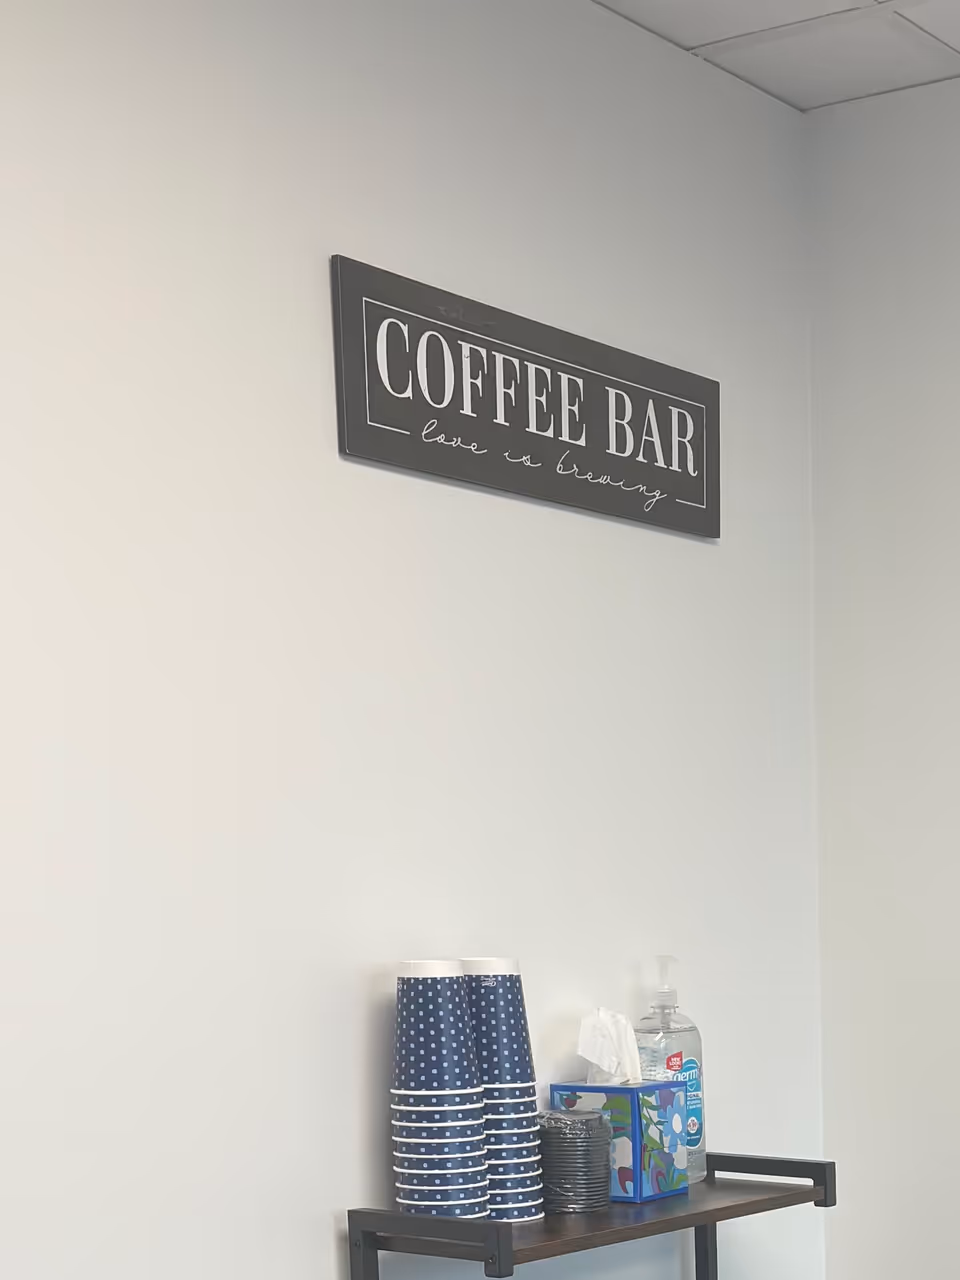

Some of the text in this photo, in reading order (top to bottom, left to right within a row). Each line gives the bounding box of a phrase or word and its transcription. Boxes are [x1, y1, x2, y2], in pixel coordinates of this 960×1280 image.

[376, 318, 698, 477] COFFEE BAR
[421, 419, 668, 512] love is brewing
